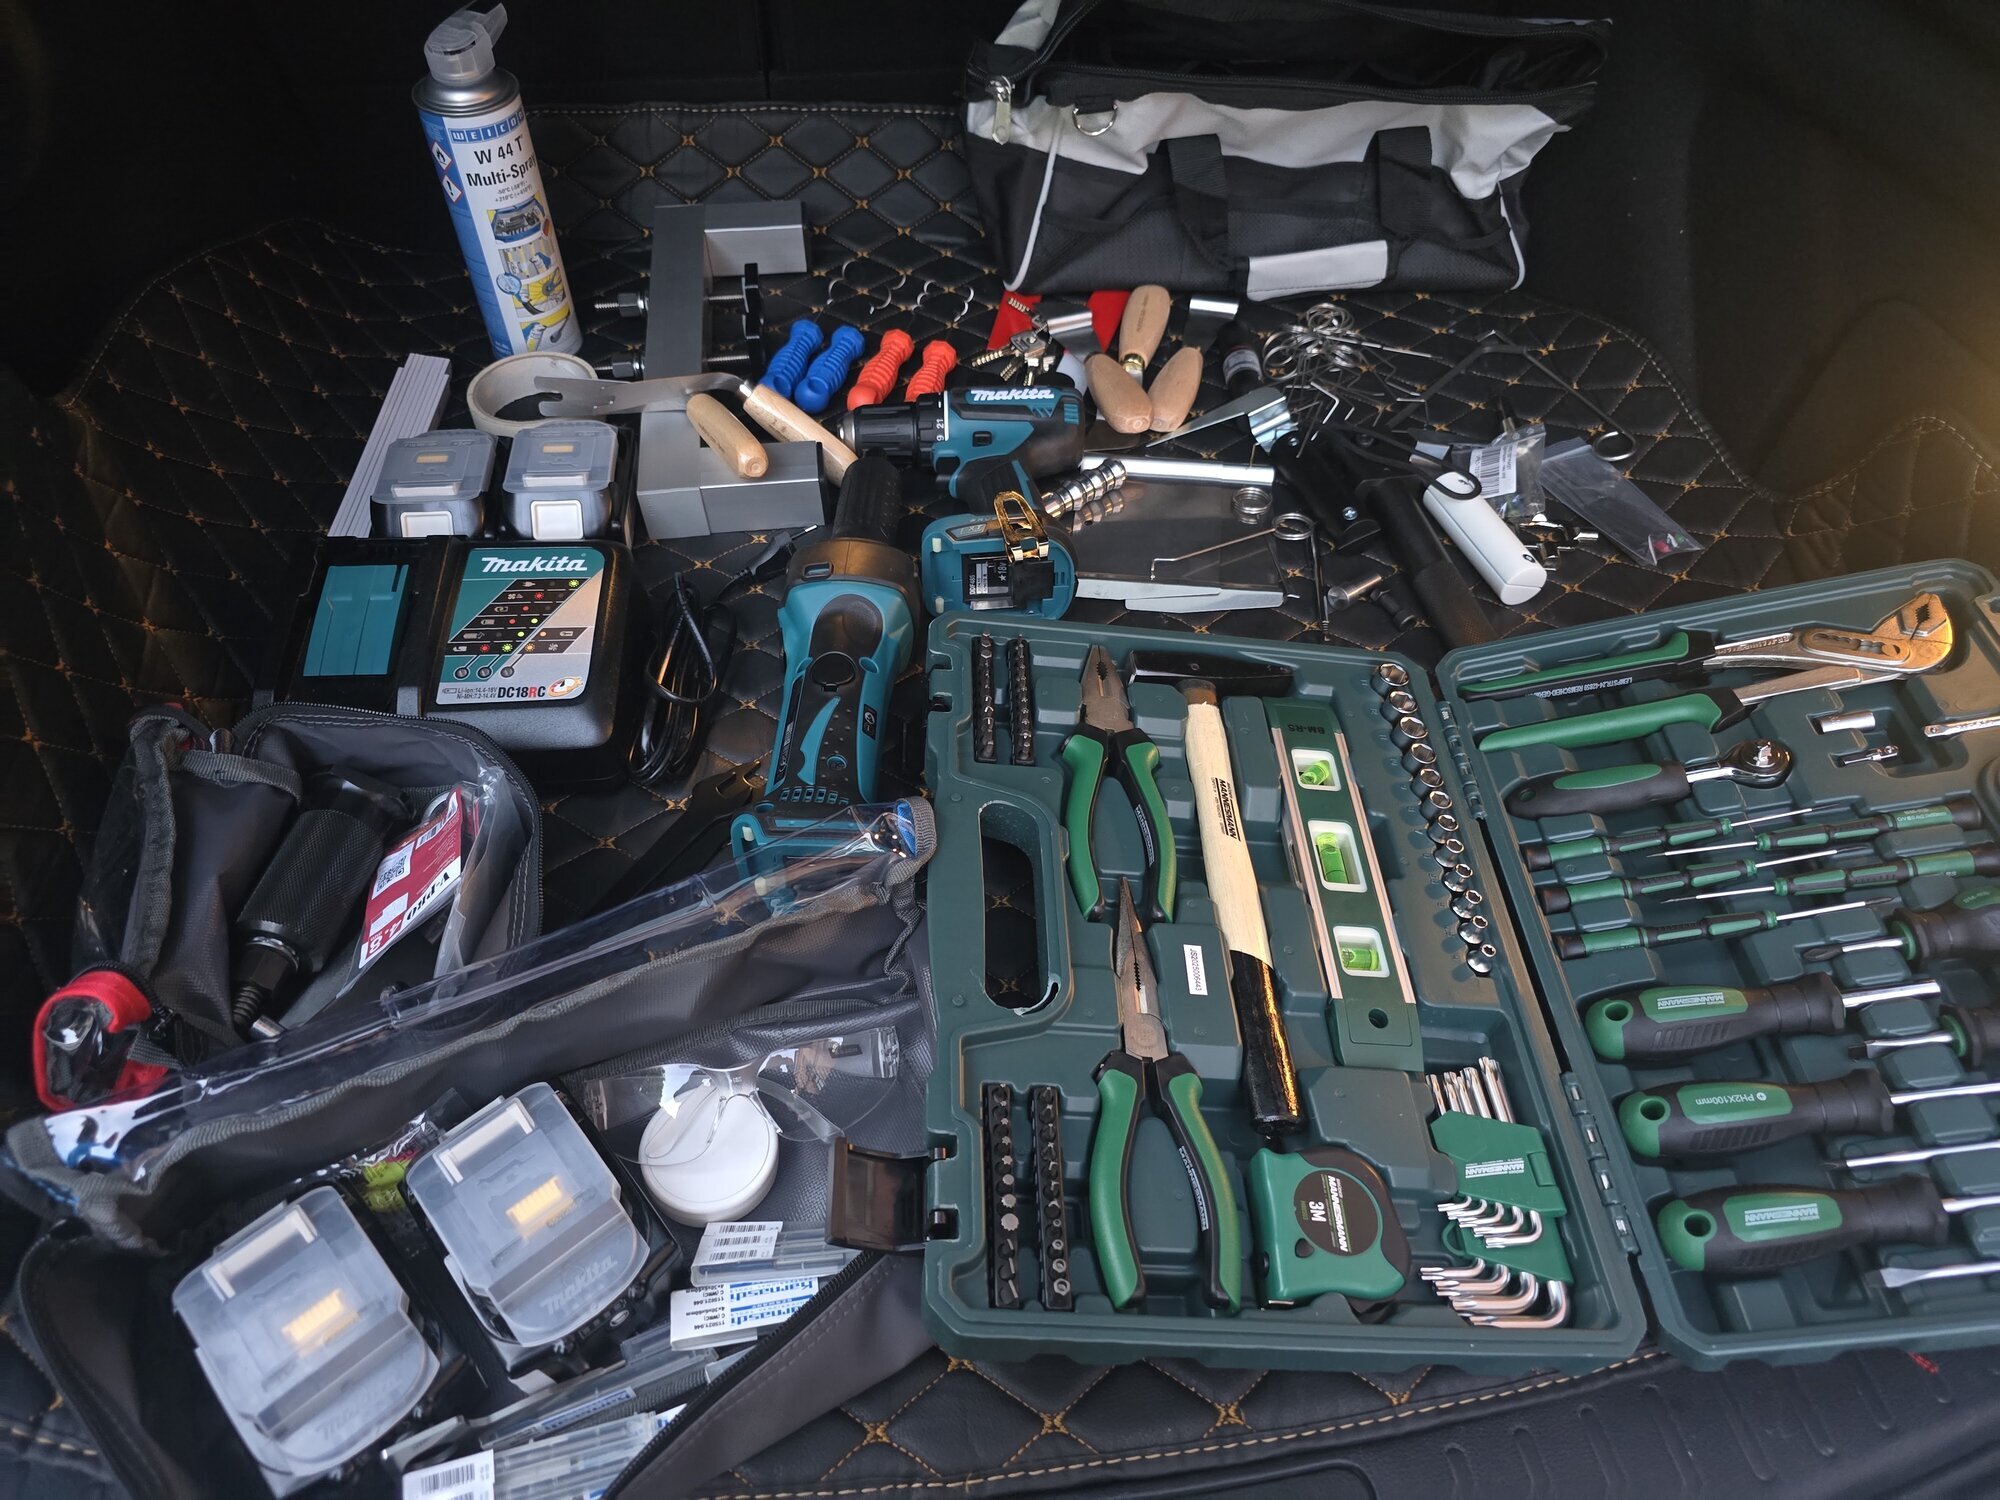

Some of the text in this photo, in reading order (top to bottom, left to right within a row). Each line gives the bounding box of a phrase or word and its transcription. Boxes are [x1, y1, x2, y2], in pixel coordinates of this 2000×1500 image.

[474, 135, 523, 165] W 44 T
[466, 155, 536, 187] Multi-Spray
[497, 686, 546, 699] DC18RC
[1218, 777, 1237, 841] MANNESMANN
[1656, 992, 1725, 1009] MANNESMANN
[1695, 1092, 1755, 1106] PH2X100mm
[1465, 1162, 1525, 1176] MANNESMANN
[1178, 1148, 1208, 1232] MANNESMANN
[1308, 1200, 1327, 1223] 3M
[1327, 1175, 1349, 1253] MANNESMANN
[1744, 1204, 1820, 1225] MANNESMANN
[730, 1306, 801, 1326] arnasch
